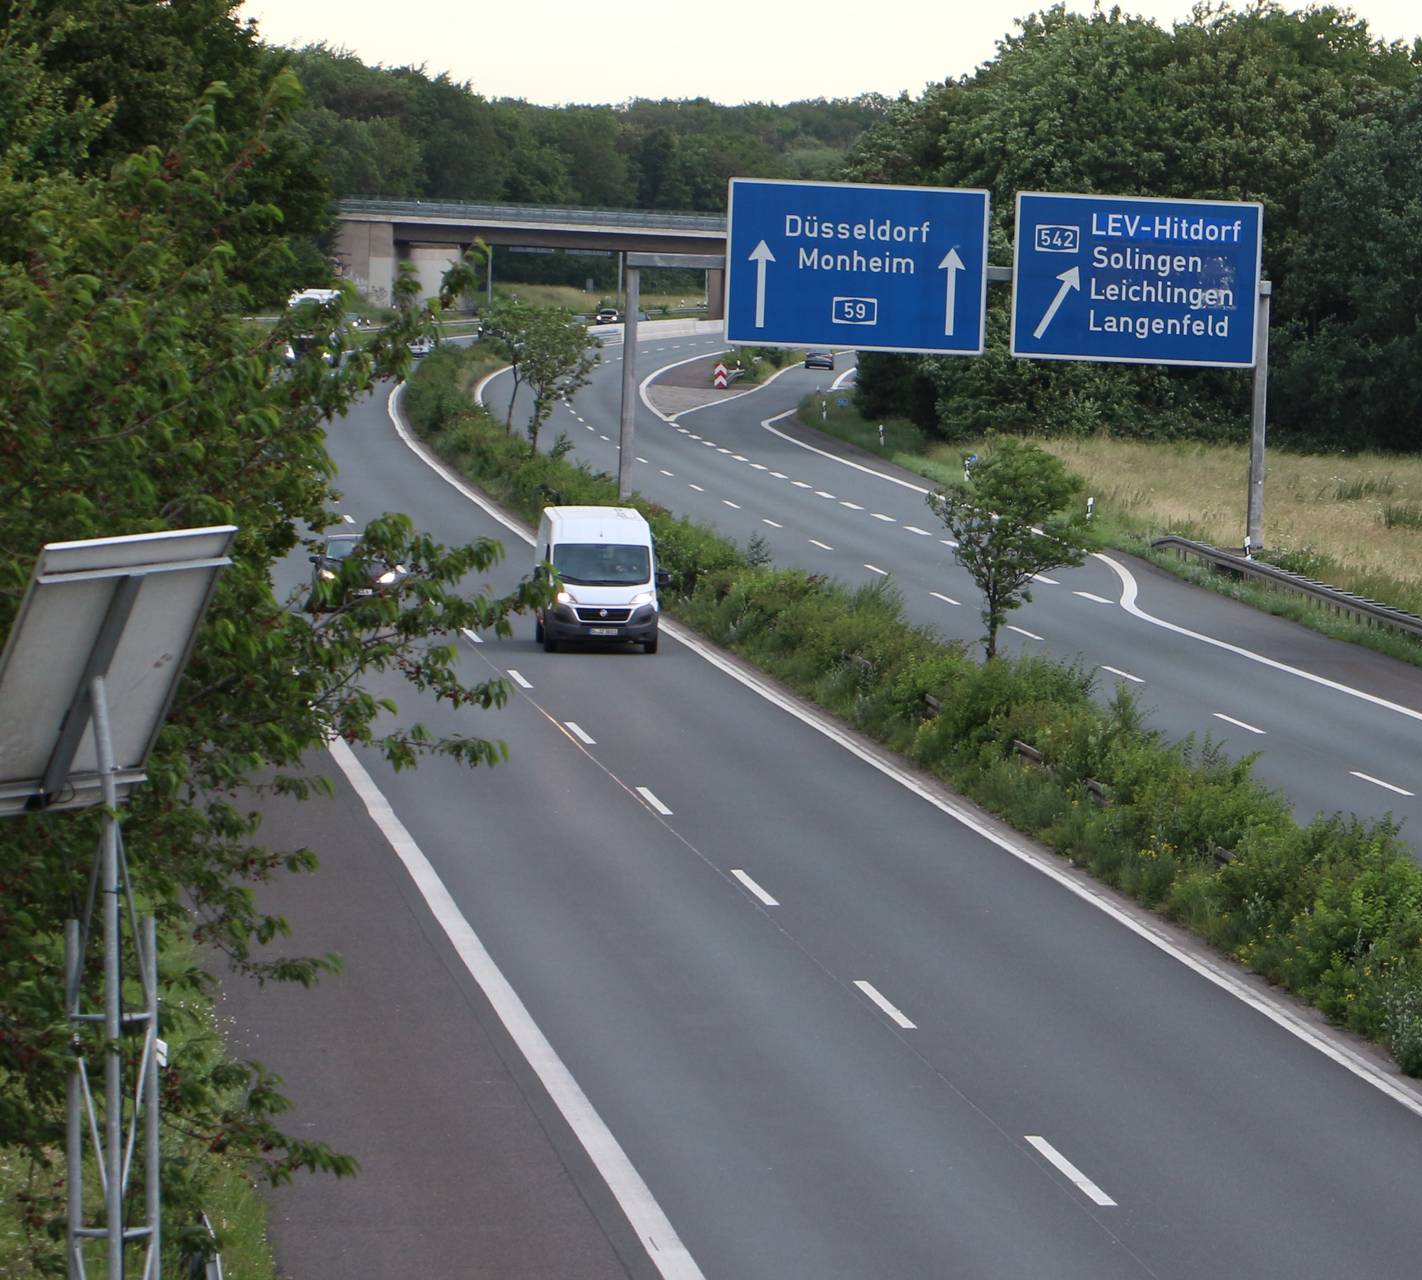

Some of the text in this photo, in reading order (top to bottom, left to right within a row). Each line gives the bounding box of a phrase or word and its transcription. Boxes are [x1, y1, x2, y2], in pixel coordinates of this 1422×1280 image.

[785, 214, 931, 243] Düsseldorf
[1040, 229, 1074, 247] 542
[1091, 212, 1242, 242] LEV-Hitdorf
[798, 247, 915, 274] Monheim
[1092, 246, 1203, 277] Solingen
[1090, 277, 1234, 310] Leichlingen
[843, 302, 867, 319] 59
[1089, 309, 1229, 339] Langenfeld
